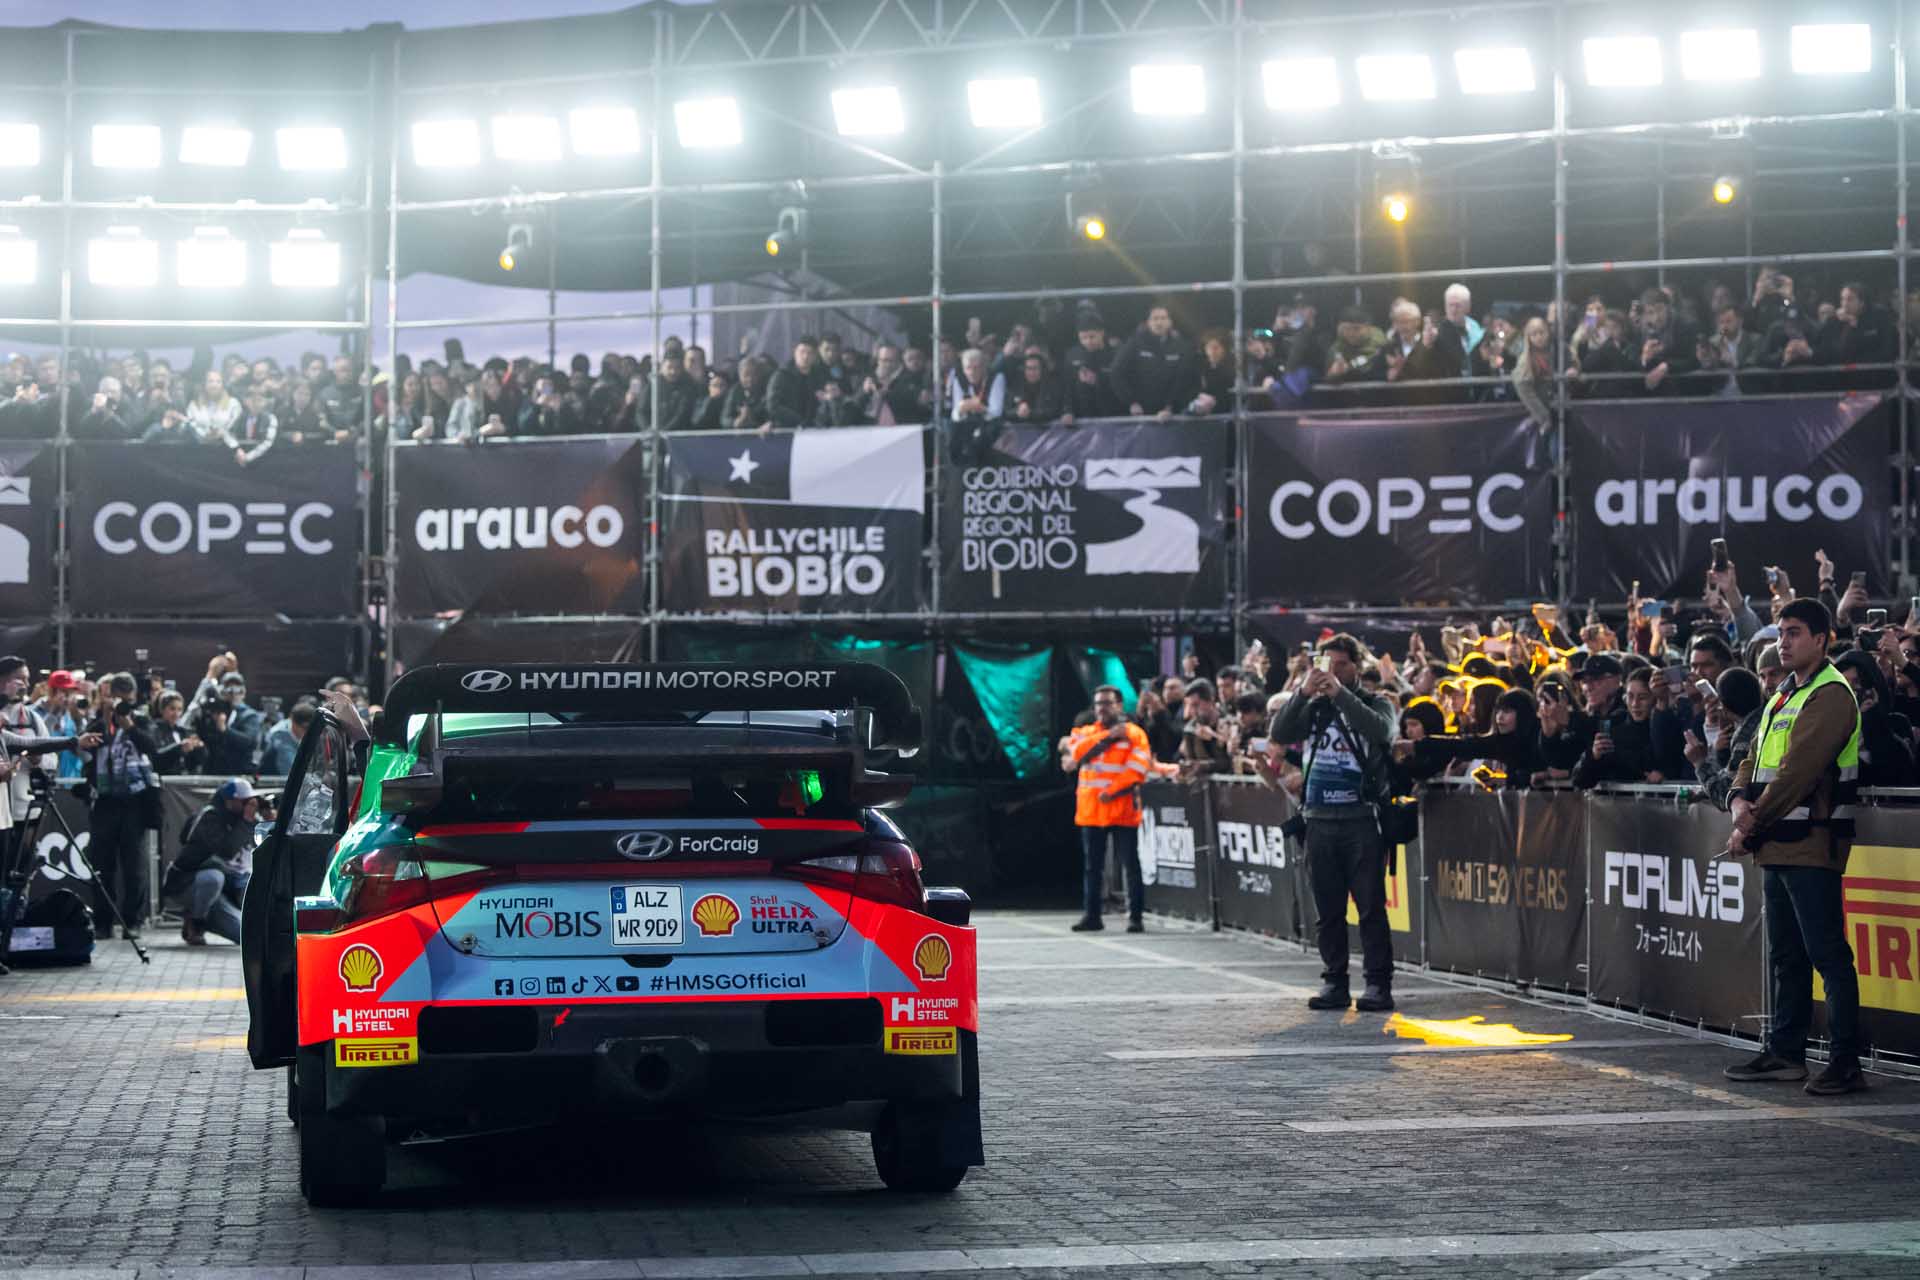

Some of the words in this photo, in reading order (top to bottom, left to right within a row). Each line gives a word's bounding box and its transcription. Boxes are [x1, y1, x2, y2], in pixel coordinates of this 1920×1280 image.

[962, 464, 1078, 489] GOBIERNO
[963, 490, 1077, 514] REGIONAL
[1269, 472, 1526, 540] COPEC
[1594, 473, 1863, 526] arauco
[93, 501, 334, 555] COPEC
[415, 504, 624, 552] arauco
[1042, 515, 1076, 535] DEL
[963, 536, 1078, 571] BIOBIO
[520, 671, 651, 690] HYUNDAI
[656, 671, 837, 689] MOTORSPORT
[679, 834, 760, 855] ForCraig
[1438, 860, 1472, 901] Mobil
[1488, 864, 1510, 905] 50
[1515, 866, 1569, 912] YEARS
[1604, 850, 1745, 924] FORUM8
[479, 897, 554, 910] HYUNDAI
[633, 892, 668, 908] ALZ
[750, 895, 778, 905] Shell
[751, 905, 815, 920] HELIX
[496, 911, 602, 938] MOBIS
[618, 920, 640, 937] WR
[645, 919, 678, 937] 909
[752, 921, 814, 934] ULTRA
[650, 973, 807, 991] #HMSGOfficial
[917, 998, 959, 1008] HYUNDAI
[355, 1008, 409, 1019] HYUNDAI
[917, 1010, 949, 1020] STEEL
[355, 1021, 395, 1032] STEEL
[892, 1032, 953, 1050] PIRELLI
[340, 1043, 410, 1062] PIRELLI
